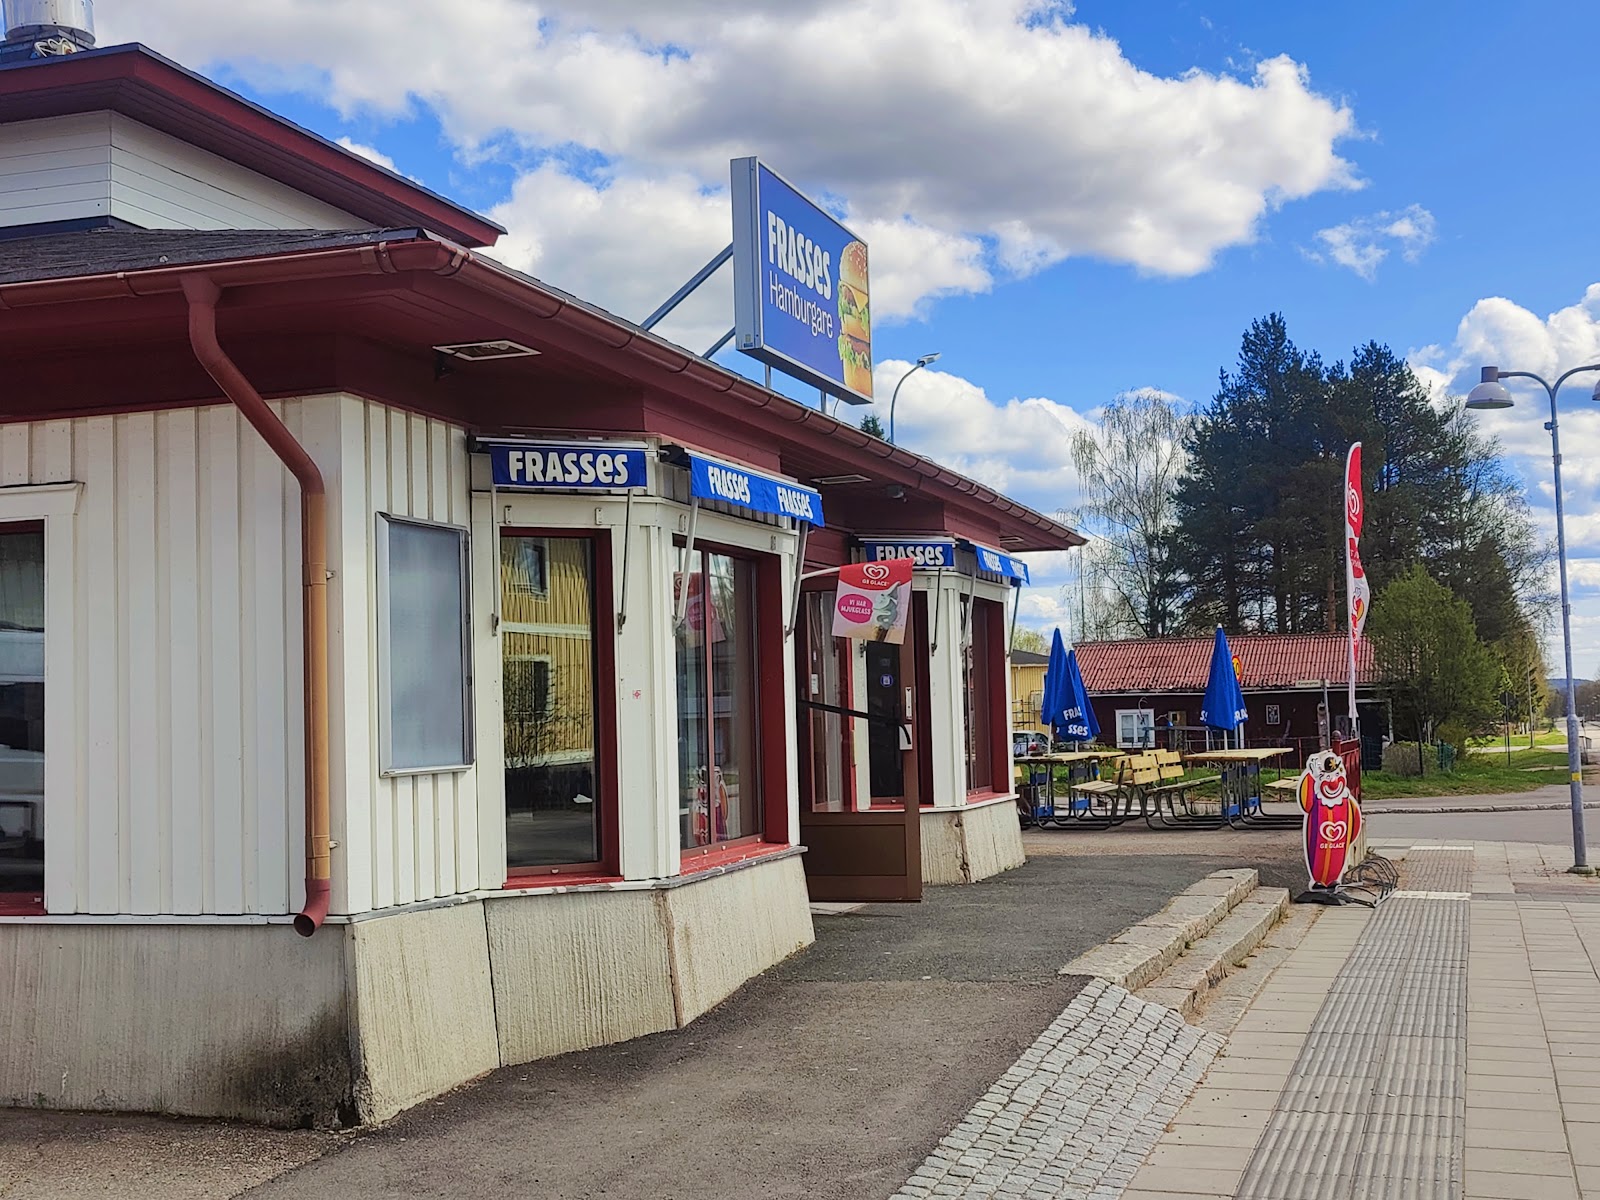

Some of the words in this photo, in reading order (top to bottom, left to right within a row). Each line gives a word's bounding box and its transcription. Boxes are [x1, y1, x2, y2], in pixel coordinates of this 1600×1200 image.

[769, 270, 833, 339] Hamburgare
[870, 579, 888, 587] GLACE
[849, 598, 855, 606] VI
[856, 599, 867, 608] HAR
[840, 605, 871, 616] MJUKGLASS
